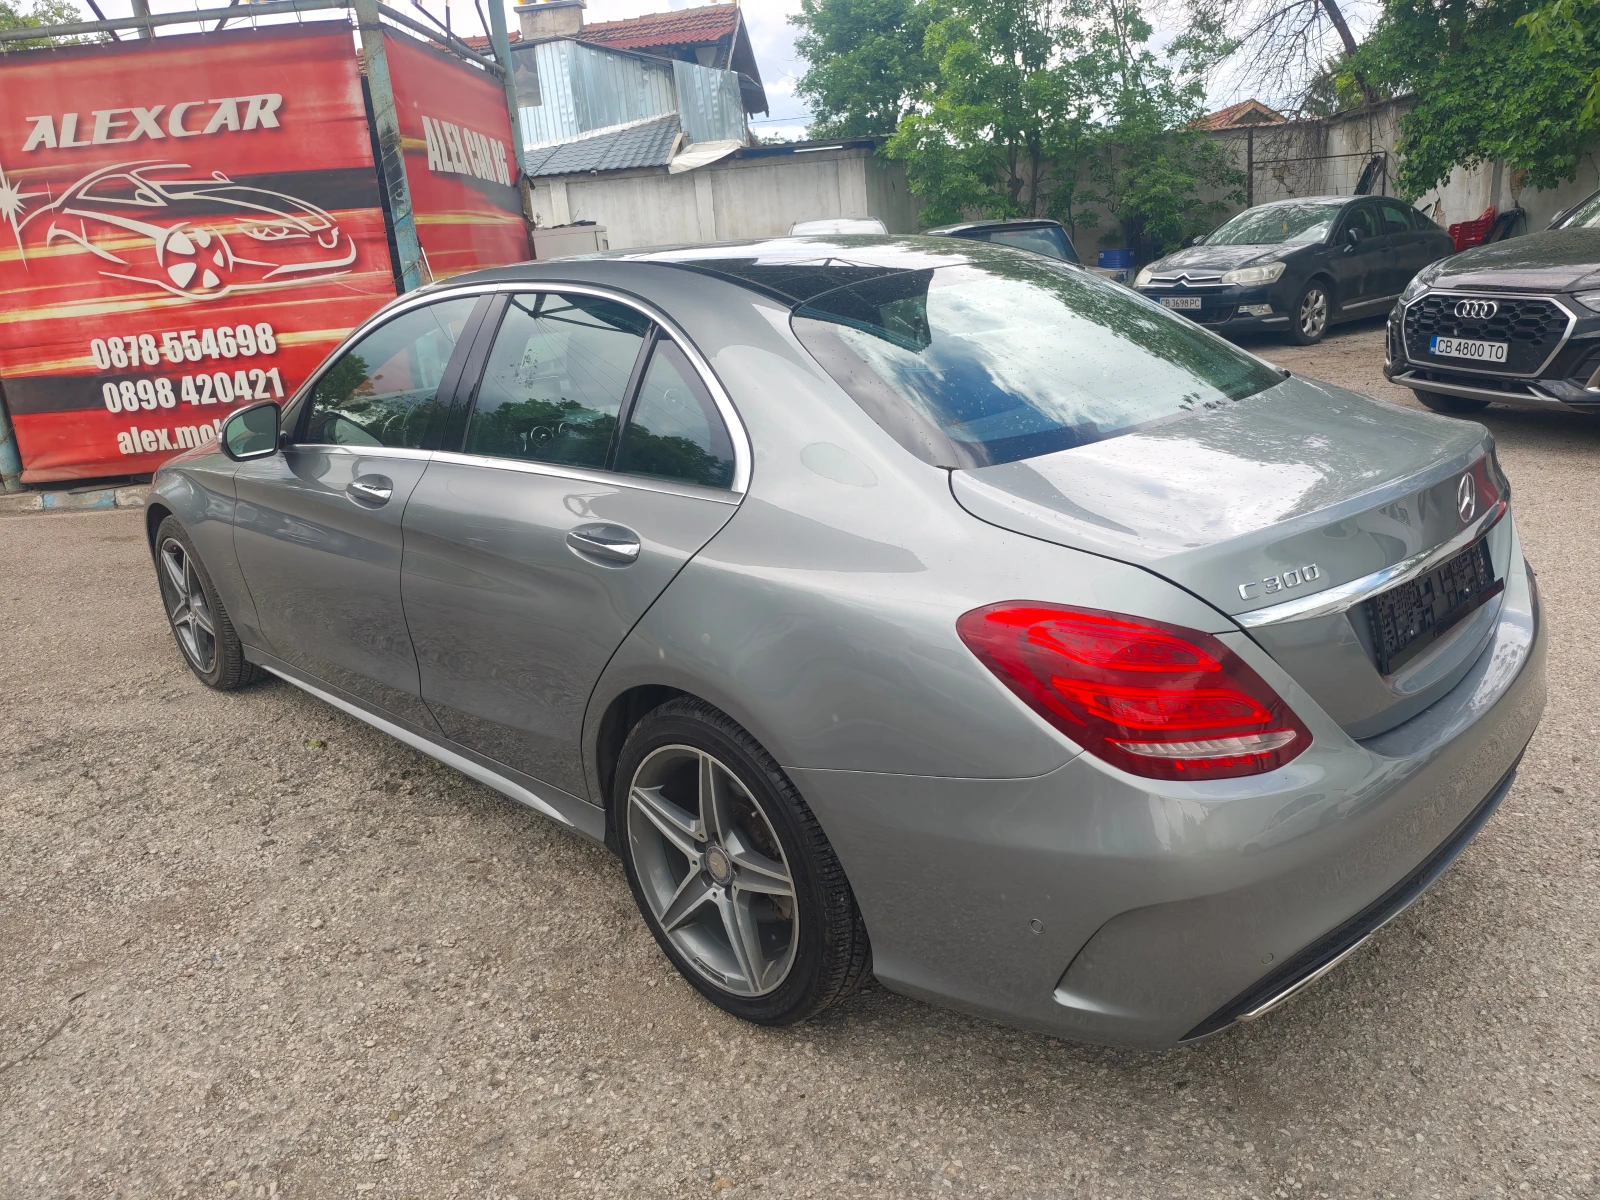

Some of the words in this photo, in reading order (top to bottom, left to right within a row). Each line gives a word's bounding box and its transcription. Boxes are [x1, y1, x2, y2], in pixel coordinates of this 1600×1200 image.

[21, 93, 283, 152] ALEXCAR
[421, 115, 472, 176] ALEX
[463, 127, 498, 183] CAR
[489, 137, 511, 187] BG
[1171, 299, 1189, 308] 3698
[1190, 299, 1200, 308] PC
[90, 333, 160, 370] 0878
[161, 322, 277, 363] 554698
[1437, 339, 1453, 354] CB
[1455, 341, 1485, 357] 4800
[1488, 344, 1505, 360] TO
[102, 377, 176, 414] 0898
[181, 367, 285, 406] 420421
[1238, 582, 1260, 601] C
[1262, 563, 1320, 594] 300
